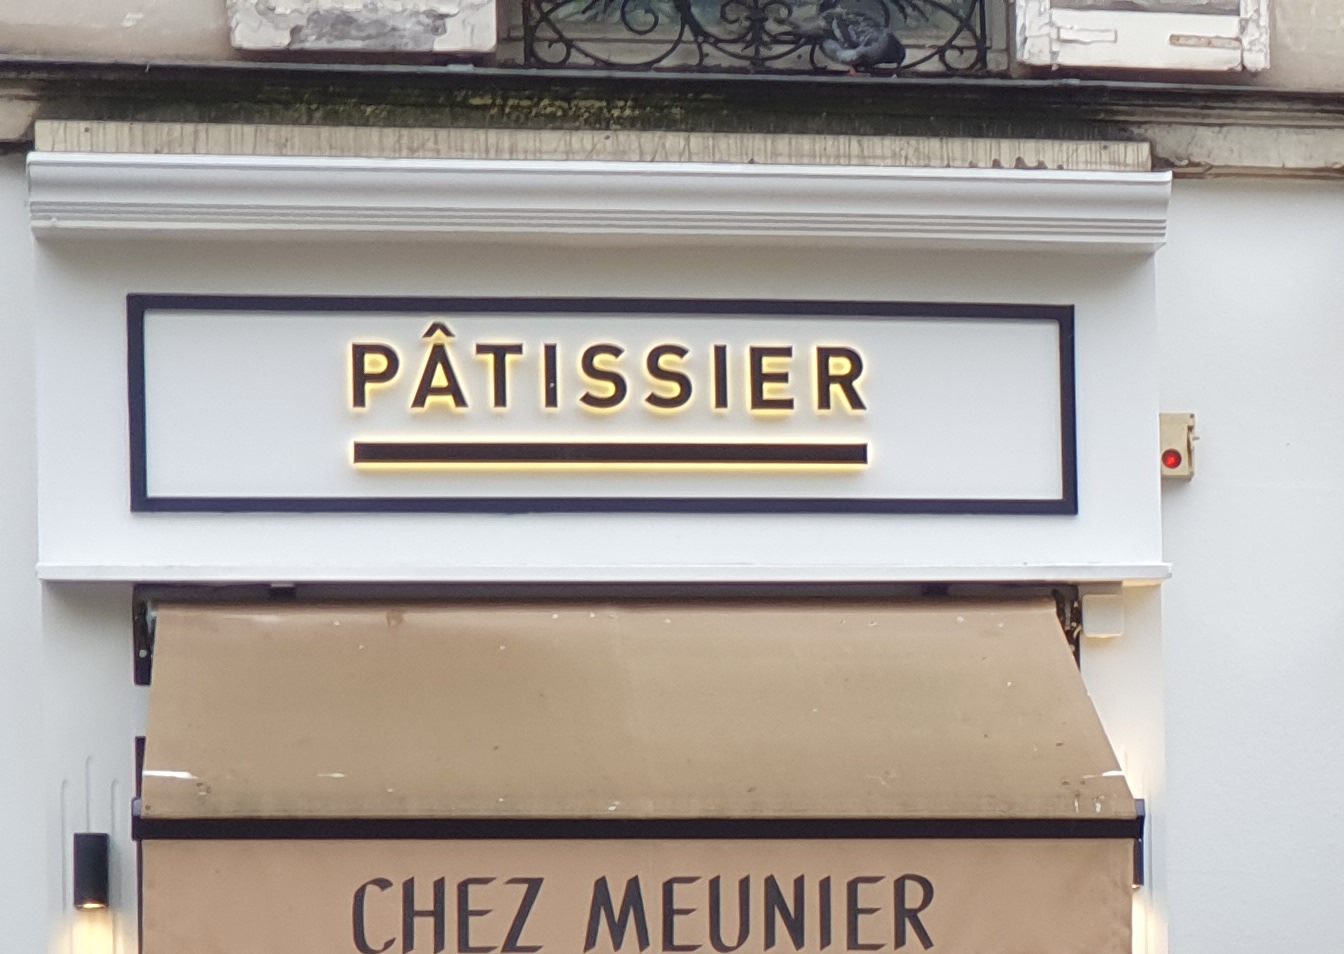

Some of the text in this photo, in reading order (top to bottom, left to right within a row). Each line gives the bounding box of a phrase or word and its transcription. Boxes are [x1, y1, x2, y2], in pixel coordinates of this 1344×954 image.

[351, 321, 868, 410] PÂTISSIER
[353, 874, 934, 954] CHEZ MEUNIER
